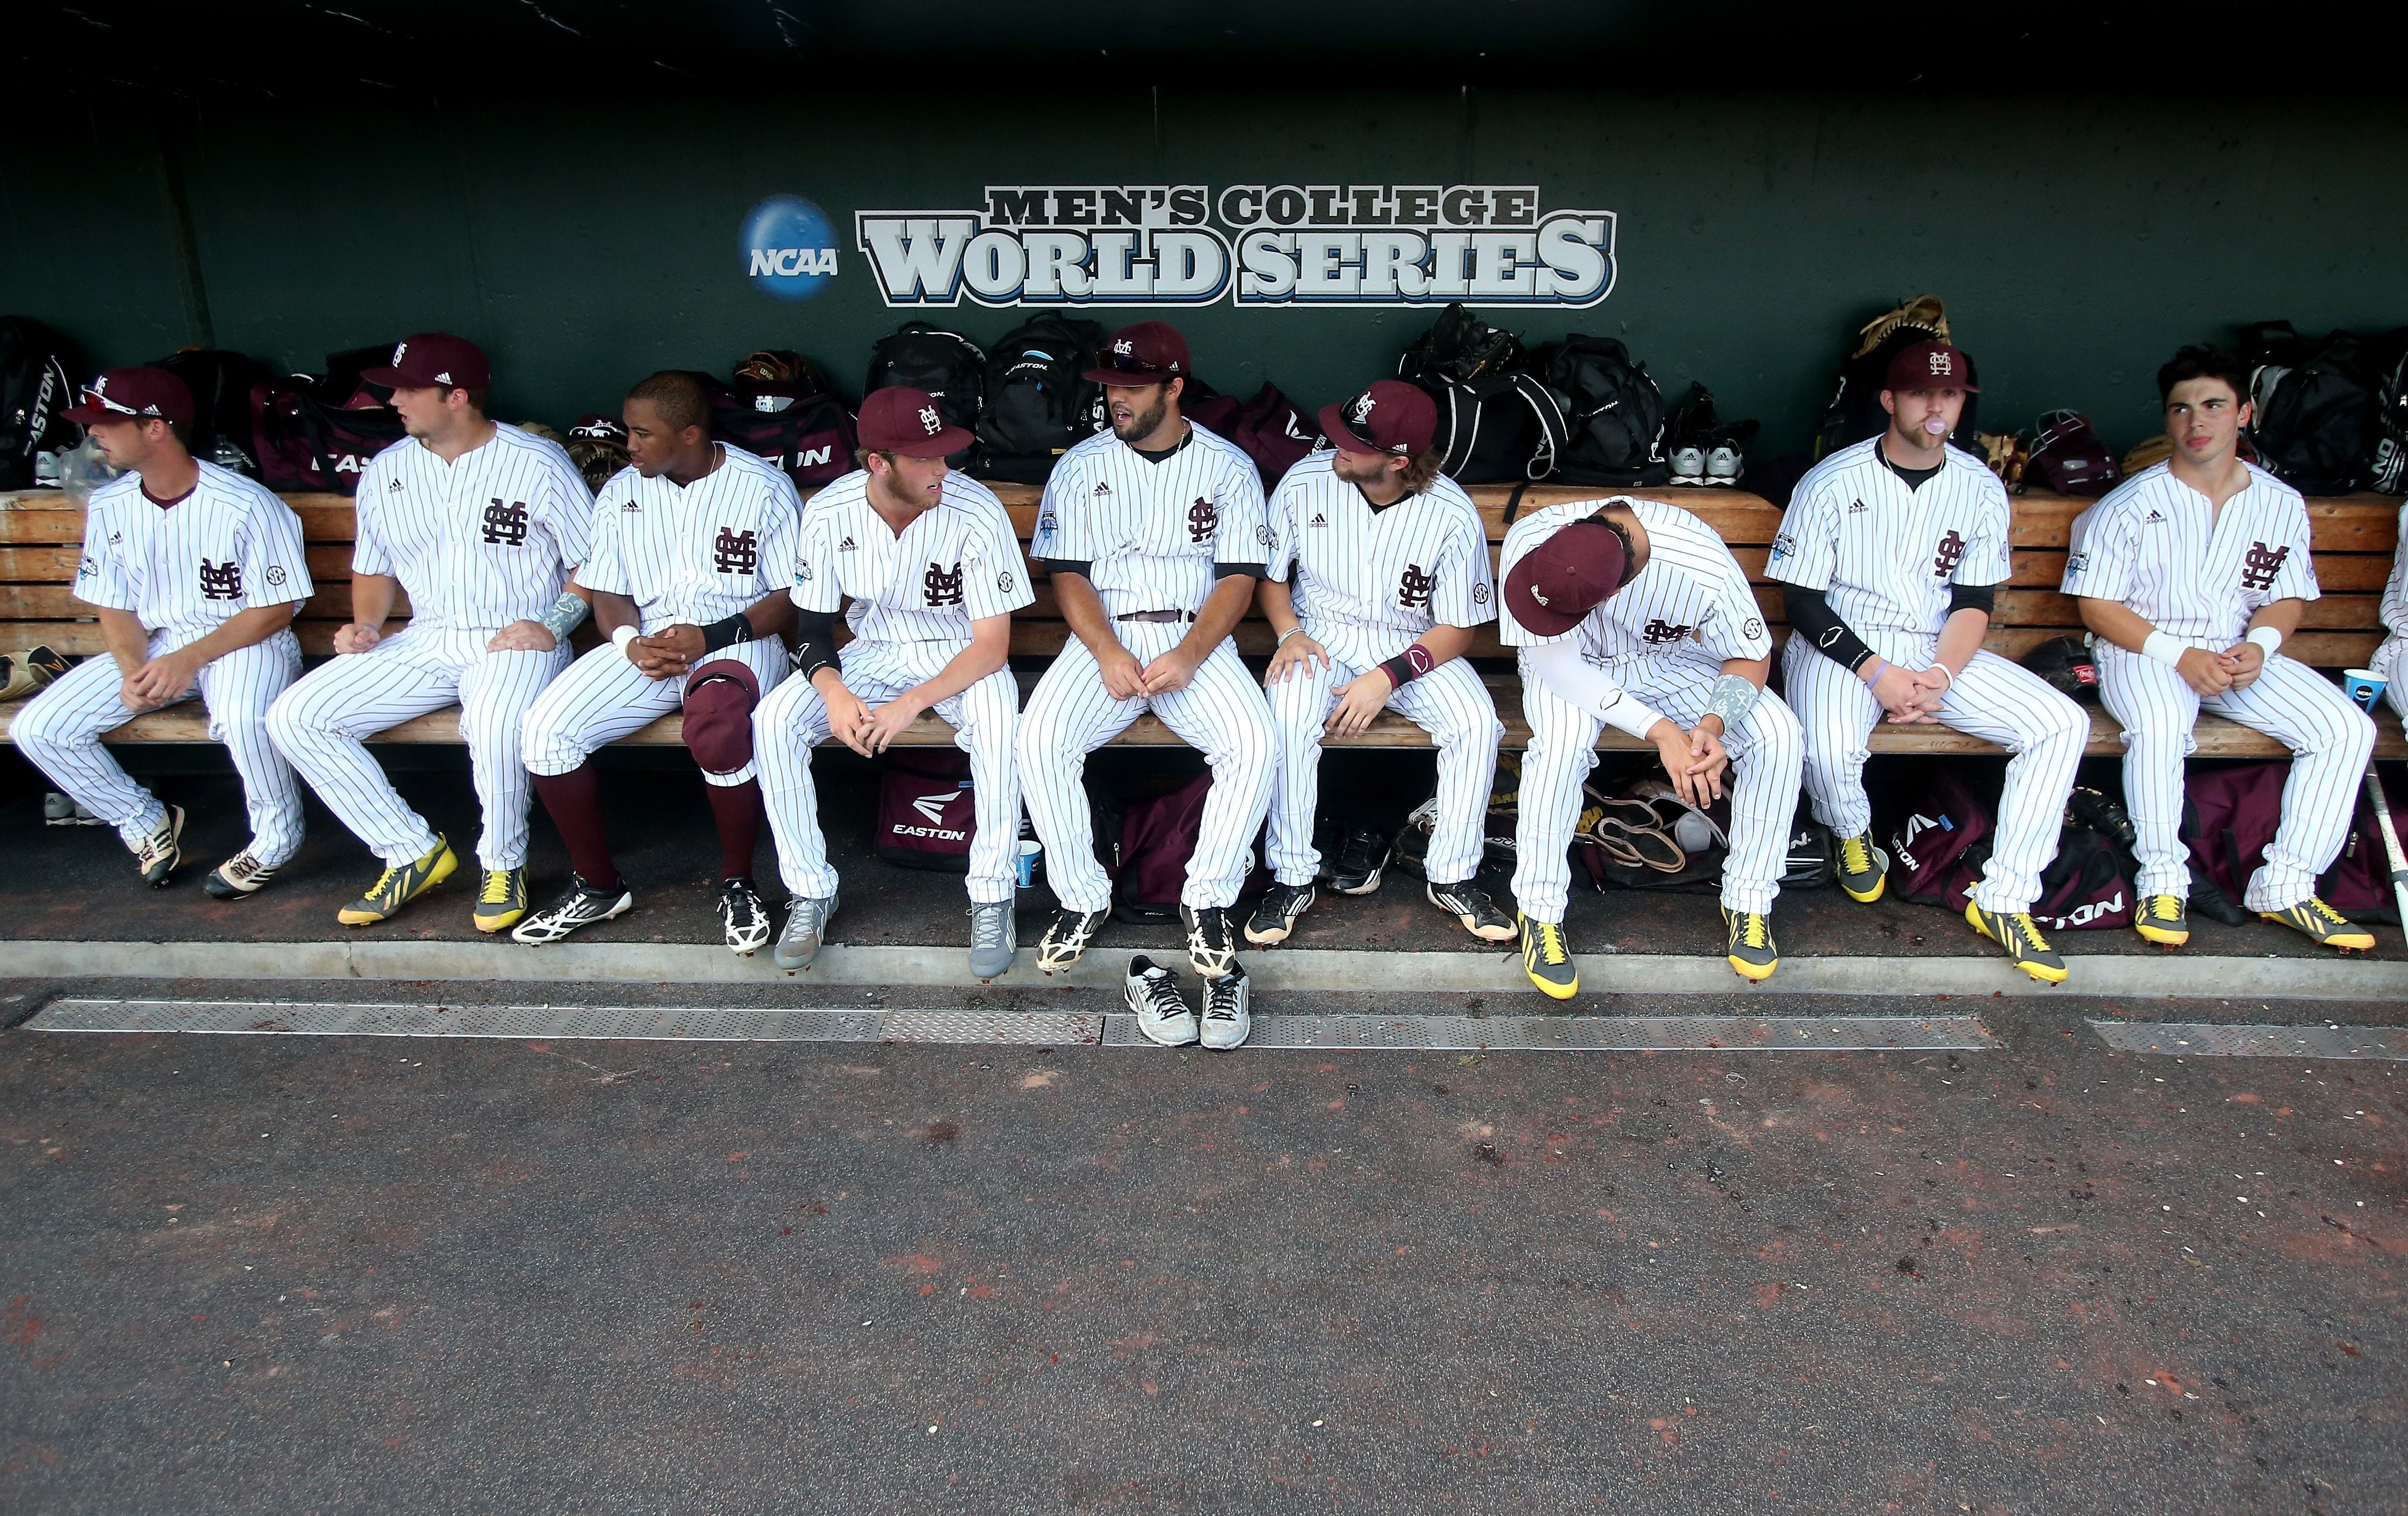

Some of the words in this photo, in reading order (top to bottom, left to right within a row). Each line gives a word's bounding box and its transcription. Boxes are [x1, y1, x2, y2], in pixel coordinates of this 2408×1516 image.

[989, 190, 1208, 226] MEN'S
[1222, 189, 1535, 225] COLLEGE
[749, 248, 839, 276] NCAA
[863, 218, 1225, 296] WORLD
[1241, 218, 1608, 300] SERIES
[1305, 434, 1327, 457] ASTON
[267, 568, 285, 584] SEC
[999, 574, 1013, 592] SEC
[1474, 585, 1488, 602] SEC
[1744, 620, 1762, 639] SEC
[892, 824, 965, 841] EASTON
